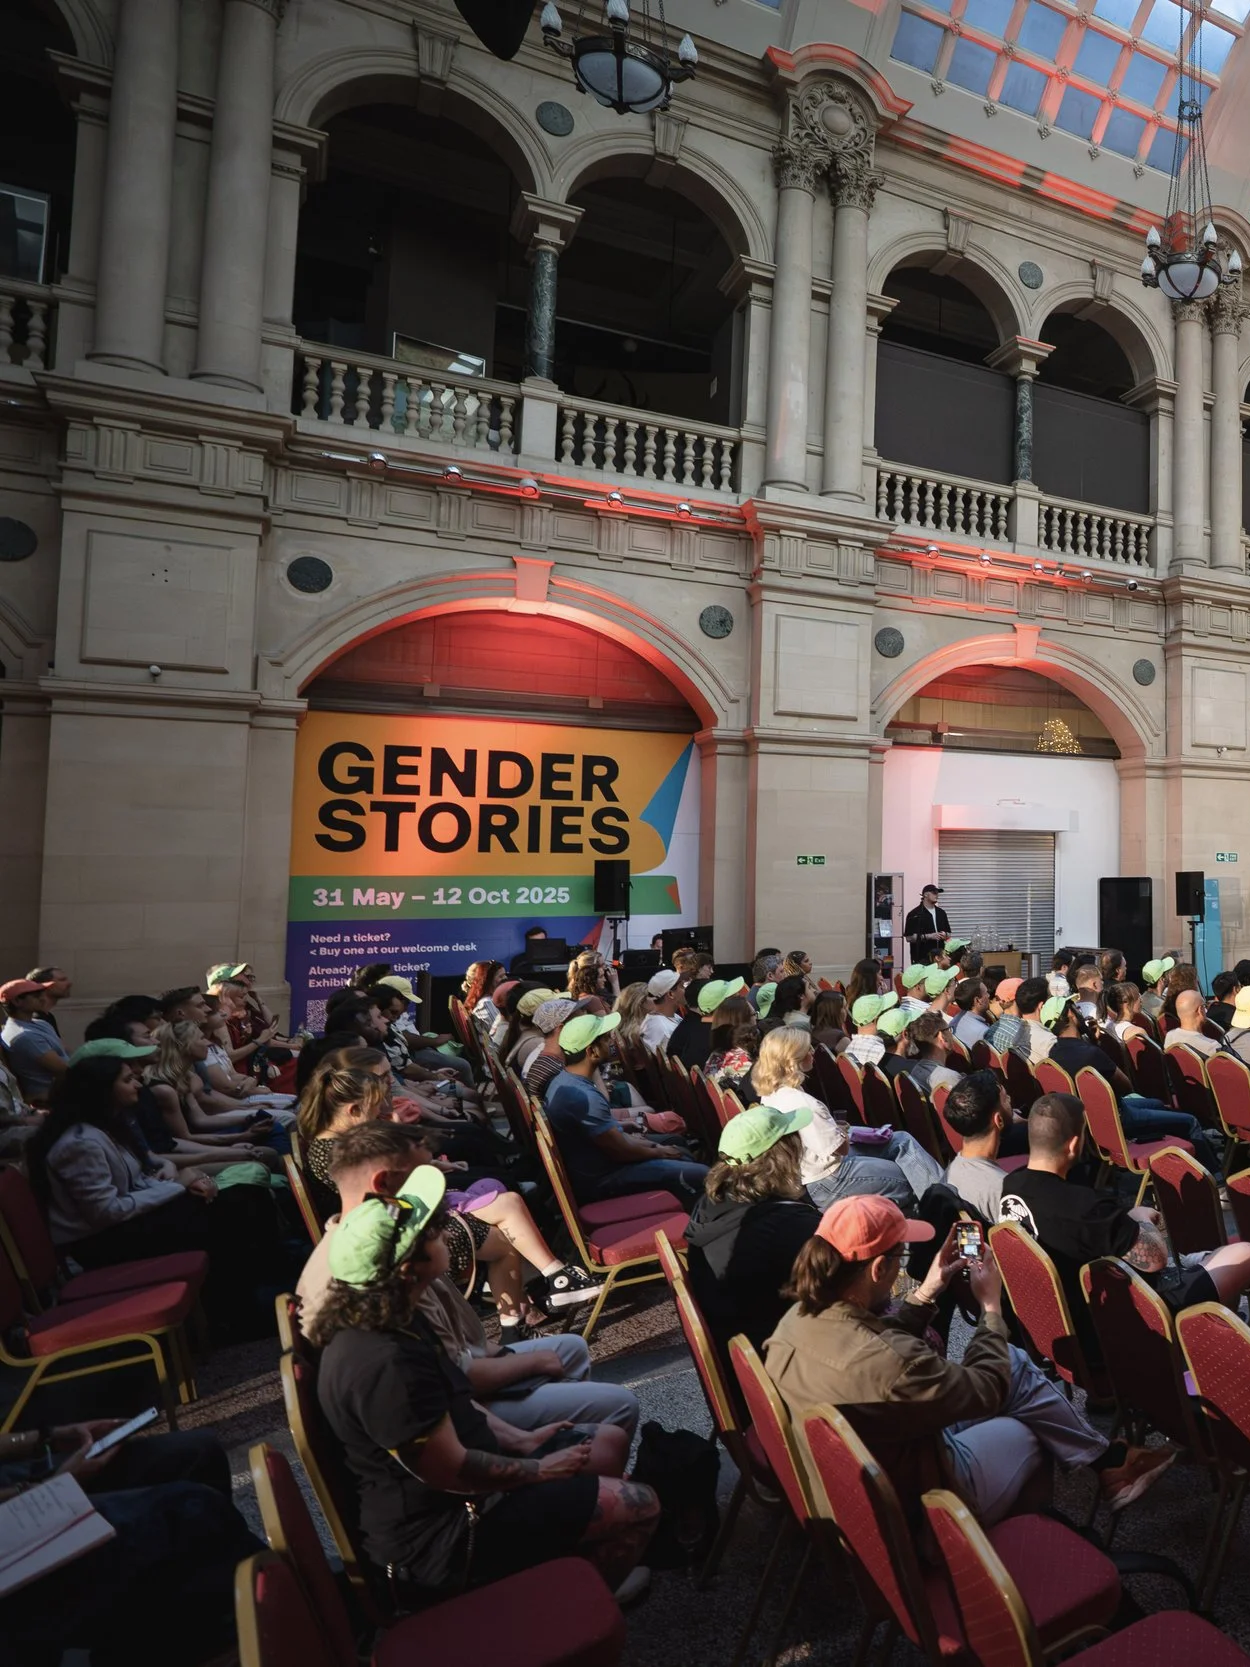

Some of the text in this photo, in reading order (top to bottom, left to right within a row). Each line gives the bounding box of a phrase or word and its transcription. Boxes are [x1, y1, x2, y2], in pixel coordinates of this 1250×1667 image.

[317, 741, 620, 802] GENDER
[314, 798, 631, 854] STORIES
[312, 888, 345, 907] 31
[352, 887, 406, 910] May
[432, 887, 462, 905] 12
[468, 887, 511, 905] Oct
[515, 886, 570, 904] 2025
[310, 933, 341, 943] Need
[353, 932, 391, 942] ticket?
[319, 946, 341, 957] Buy
[343, 946, 365, 955] one
[366, 945, 379, 954] at
[380, 945, 400, 954] our
[401, 943, 450, 953] welcome
[451, 942, 477, 952] desk
[308, 964, 353, 976] Already
[393, 962, 431, 972] ticket?
